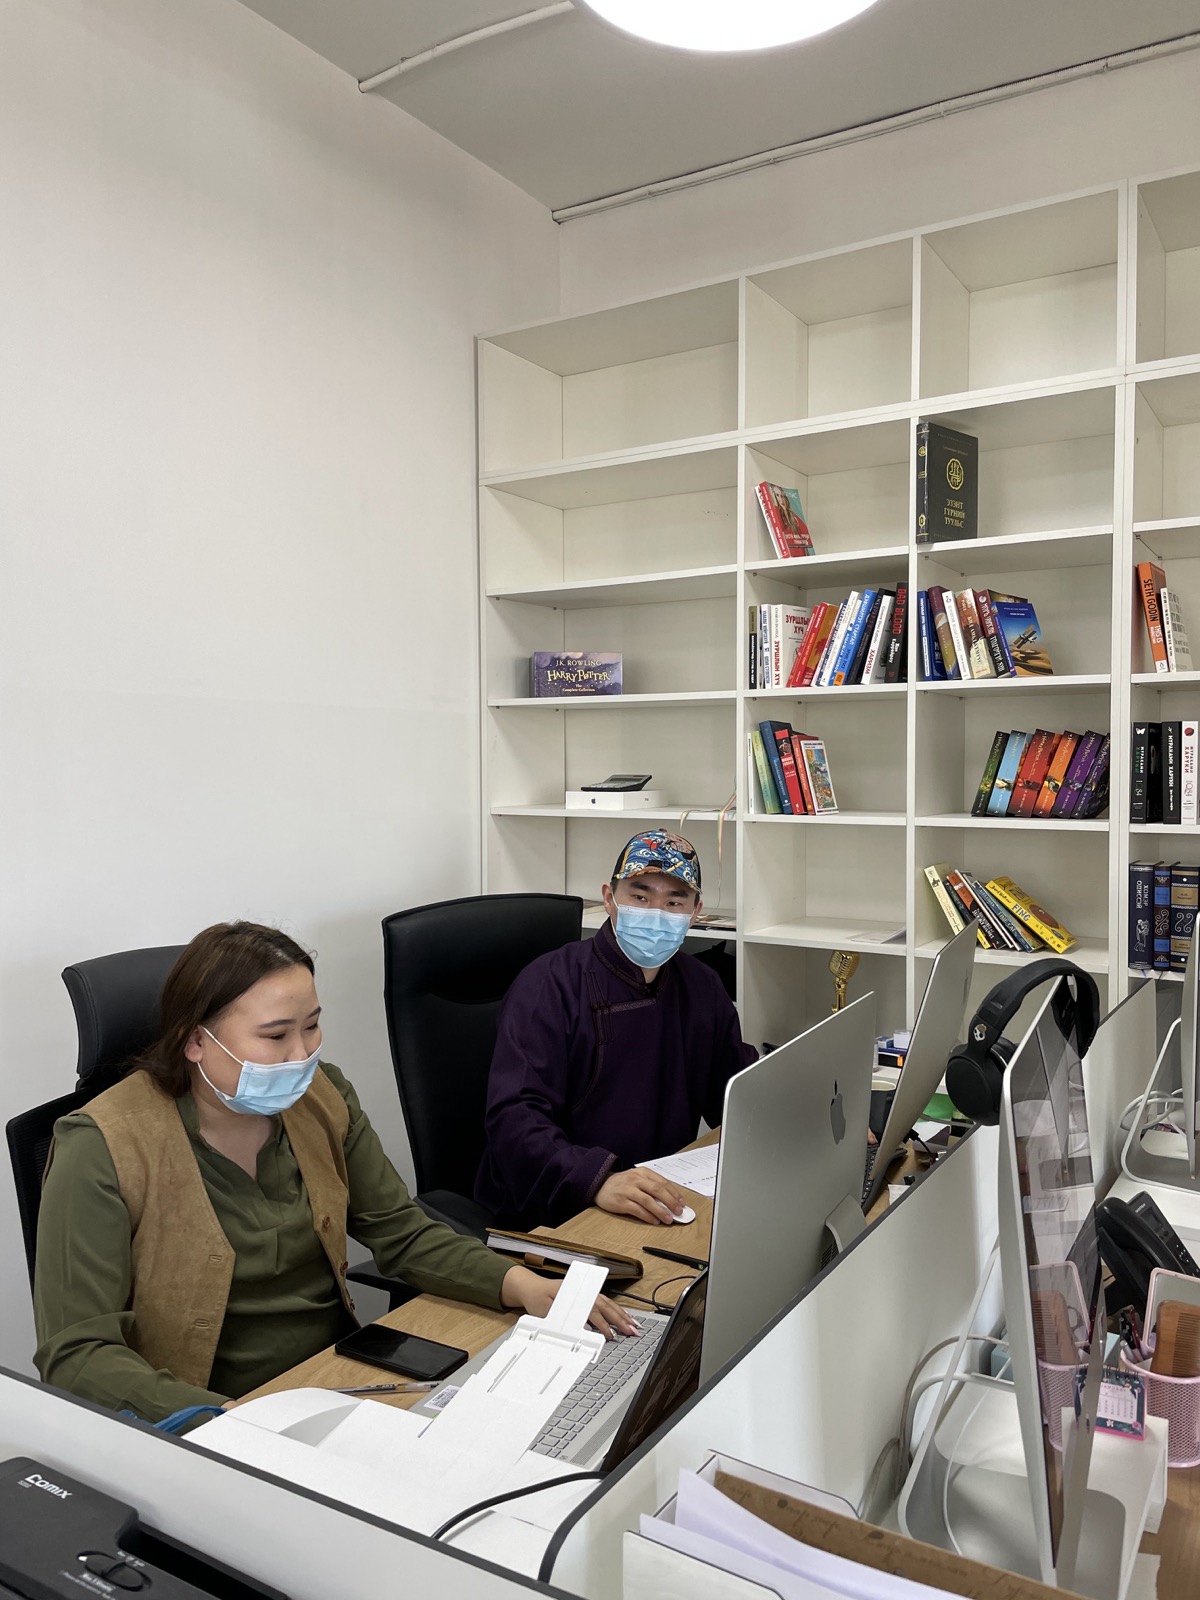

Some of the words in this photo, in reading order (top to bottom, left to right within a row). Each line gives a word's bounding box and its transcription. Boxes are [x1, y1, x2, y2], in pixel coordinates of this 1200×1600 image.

[896, 588, 906, 605] BAD
[1144, 579, 1154, 597] SETH
[1147, 600, 1158, 622] GODIN
[892, 608, 904, 635] BLOOD
[1012, 903, 1031, 921] FING
